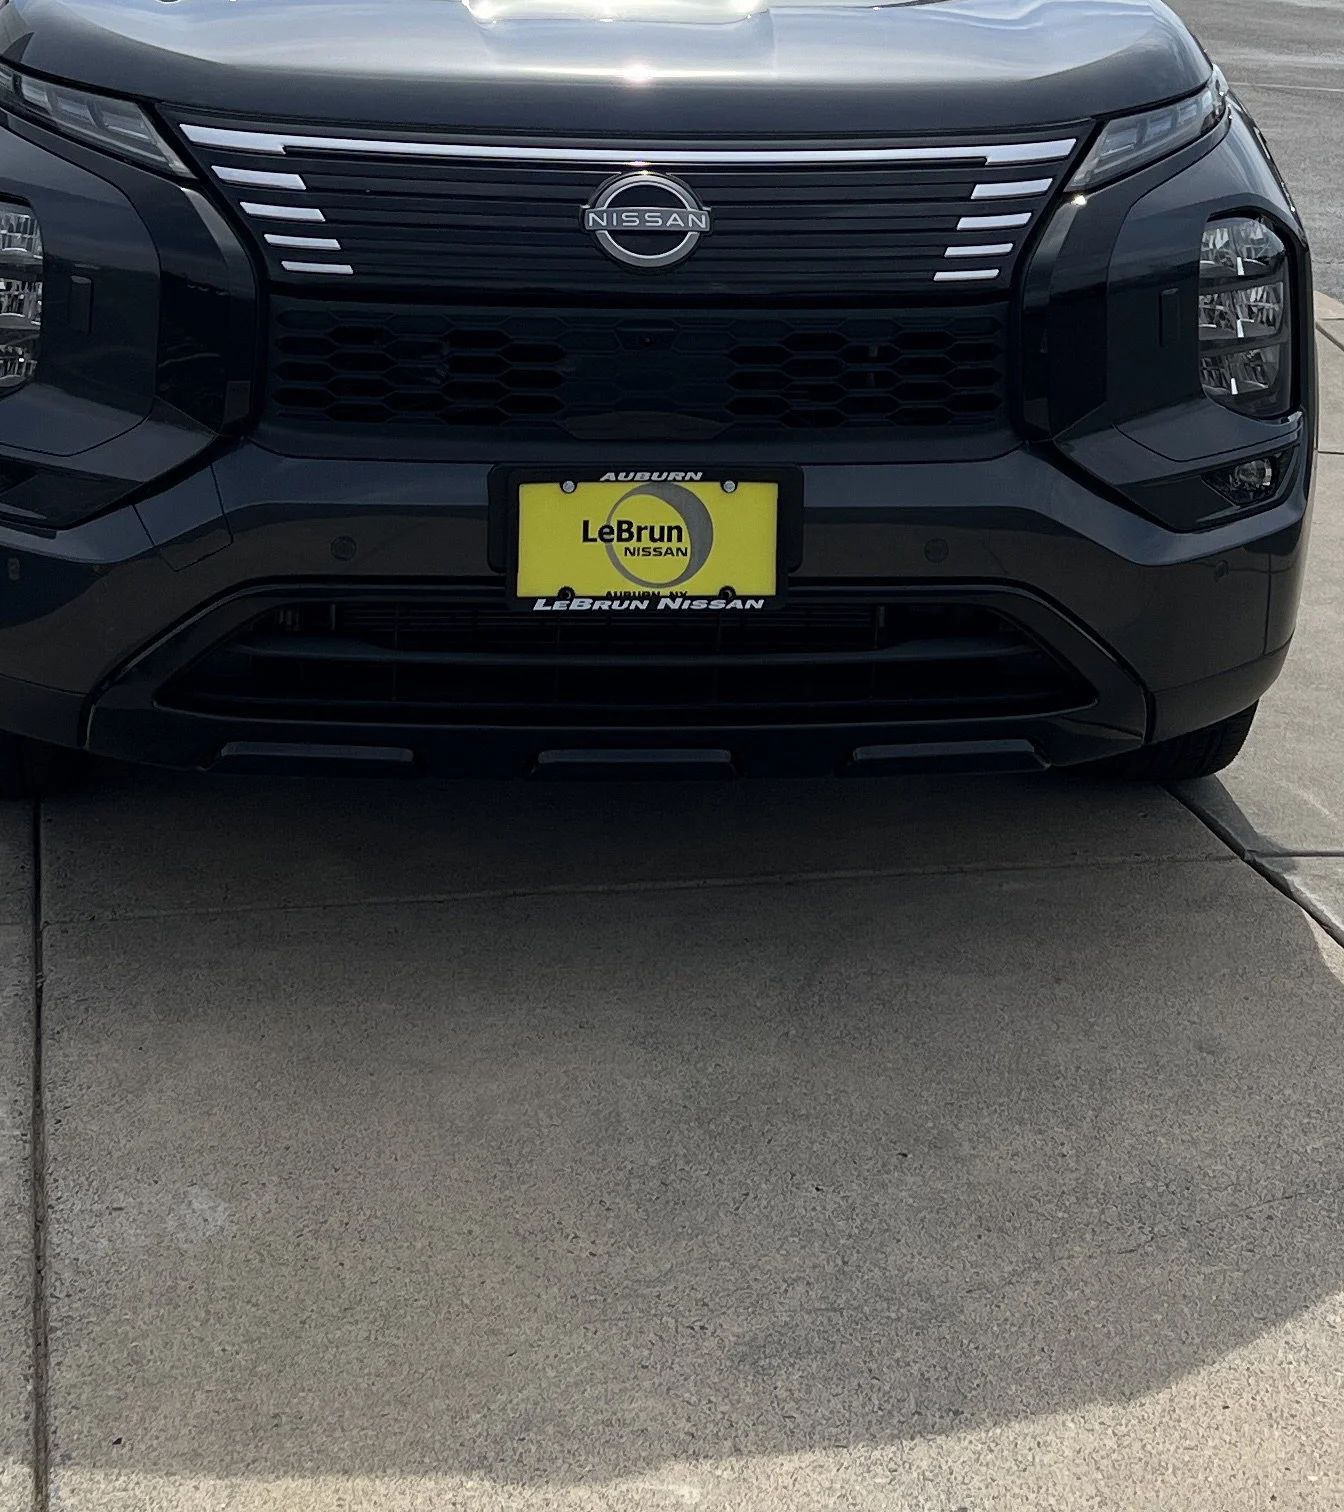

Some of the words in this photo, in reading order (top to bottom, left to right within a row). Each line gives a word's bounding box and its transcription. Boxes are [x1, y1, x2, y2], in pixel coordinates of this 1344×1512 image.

[588, 212, 707, 229] NISSAN
[599, 471, 703, 482] AUBURN
[582, 519, 683, 544] LeBrun
[624, 546, 688, 557] NISSAN
